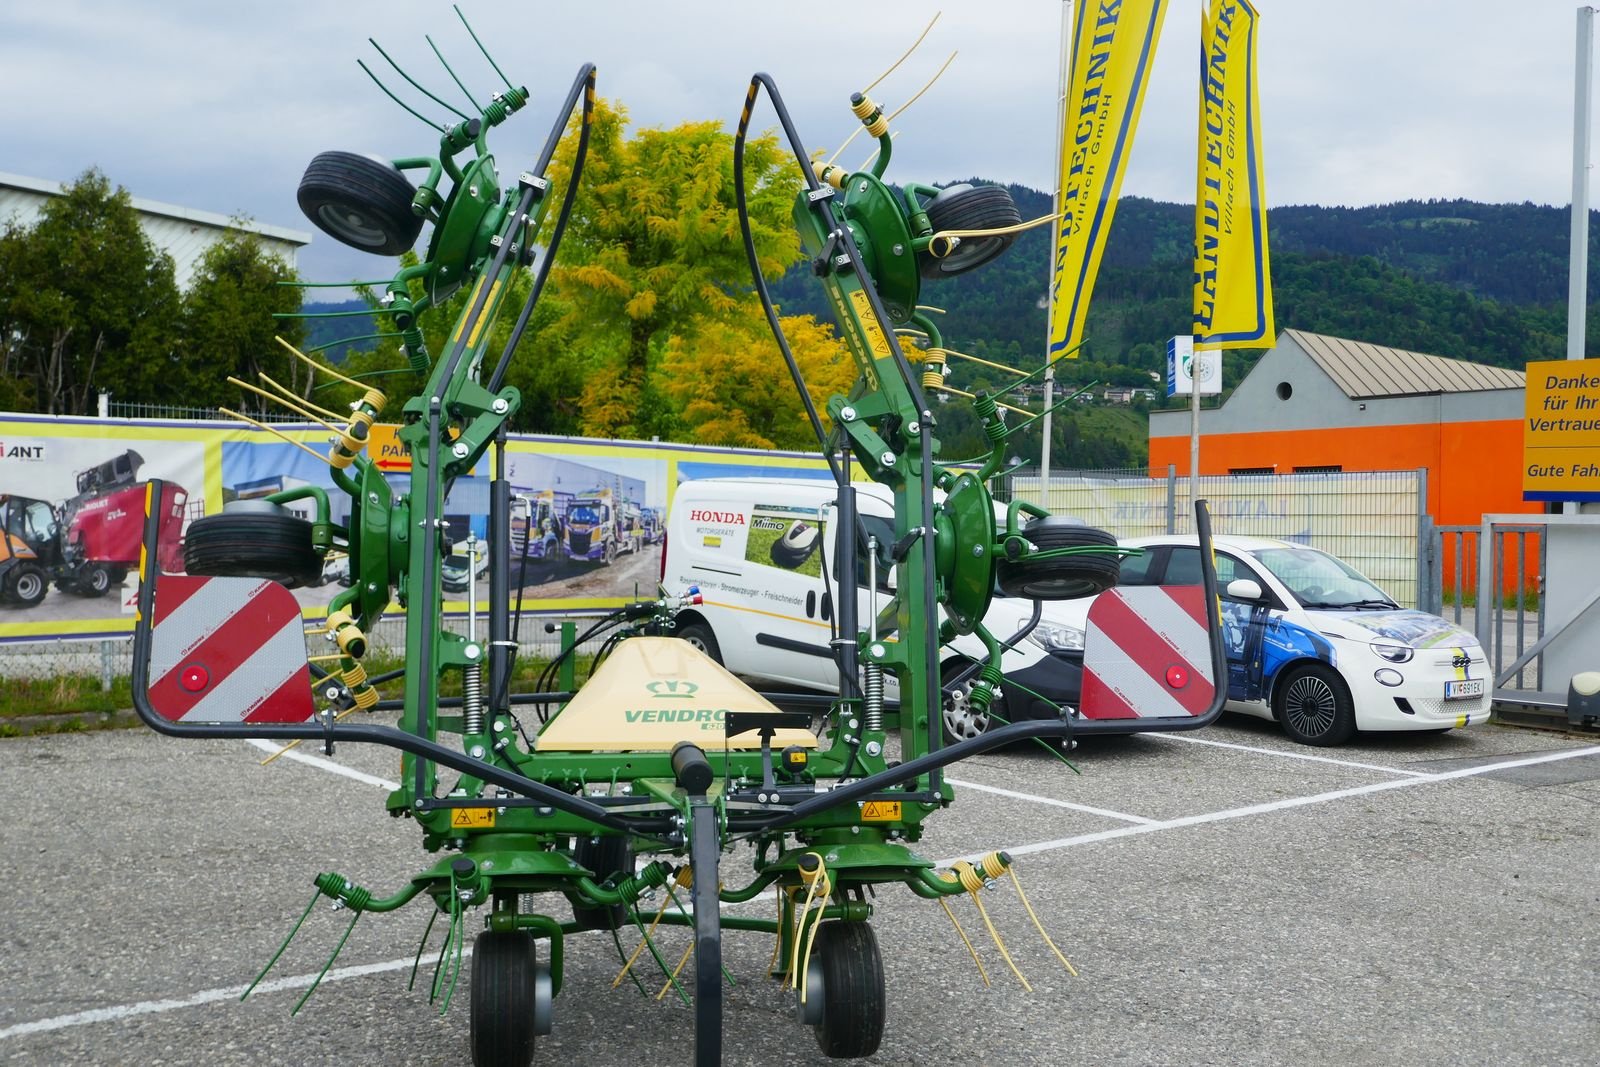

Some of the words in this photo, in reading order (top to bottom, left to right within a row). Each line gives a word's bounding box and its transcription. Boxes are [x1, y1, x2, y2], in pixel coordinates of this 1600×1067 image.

[1226, 100, 1236, 159] GmbH
[1074, 165, 1095, 234] Villach
[1091, 95, 1112, 155] GmbH
[1225, 167, 1235, 235] Villach
[831, 286, 869, 364] KRONE
[1545, 374, 1600, 390] Danke
[1543, 395, 1568, 411] für
[1576, 394, 1599, 410] Ihr
[1527, 464, 1564, 477] Gute
[1571, 463, 1600, 477] Fah
[690, 509, 745, 525] HONDA
[752, 517, 785, 530] Miimo
[720, 582, 760, 597] Stromerzeuger
[764, 590, 804, 606] Freischneider
[625, 709, 730, 723] VENDRO
